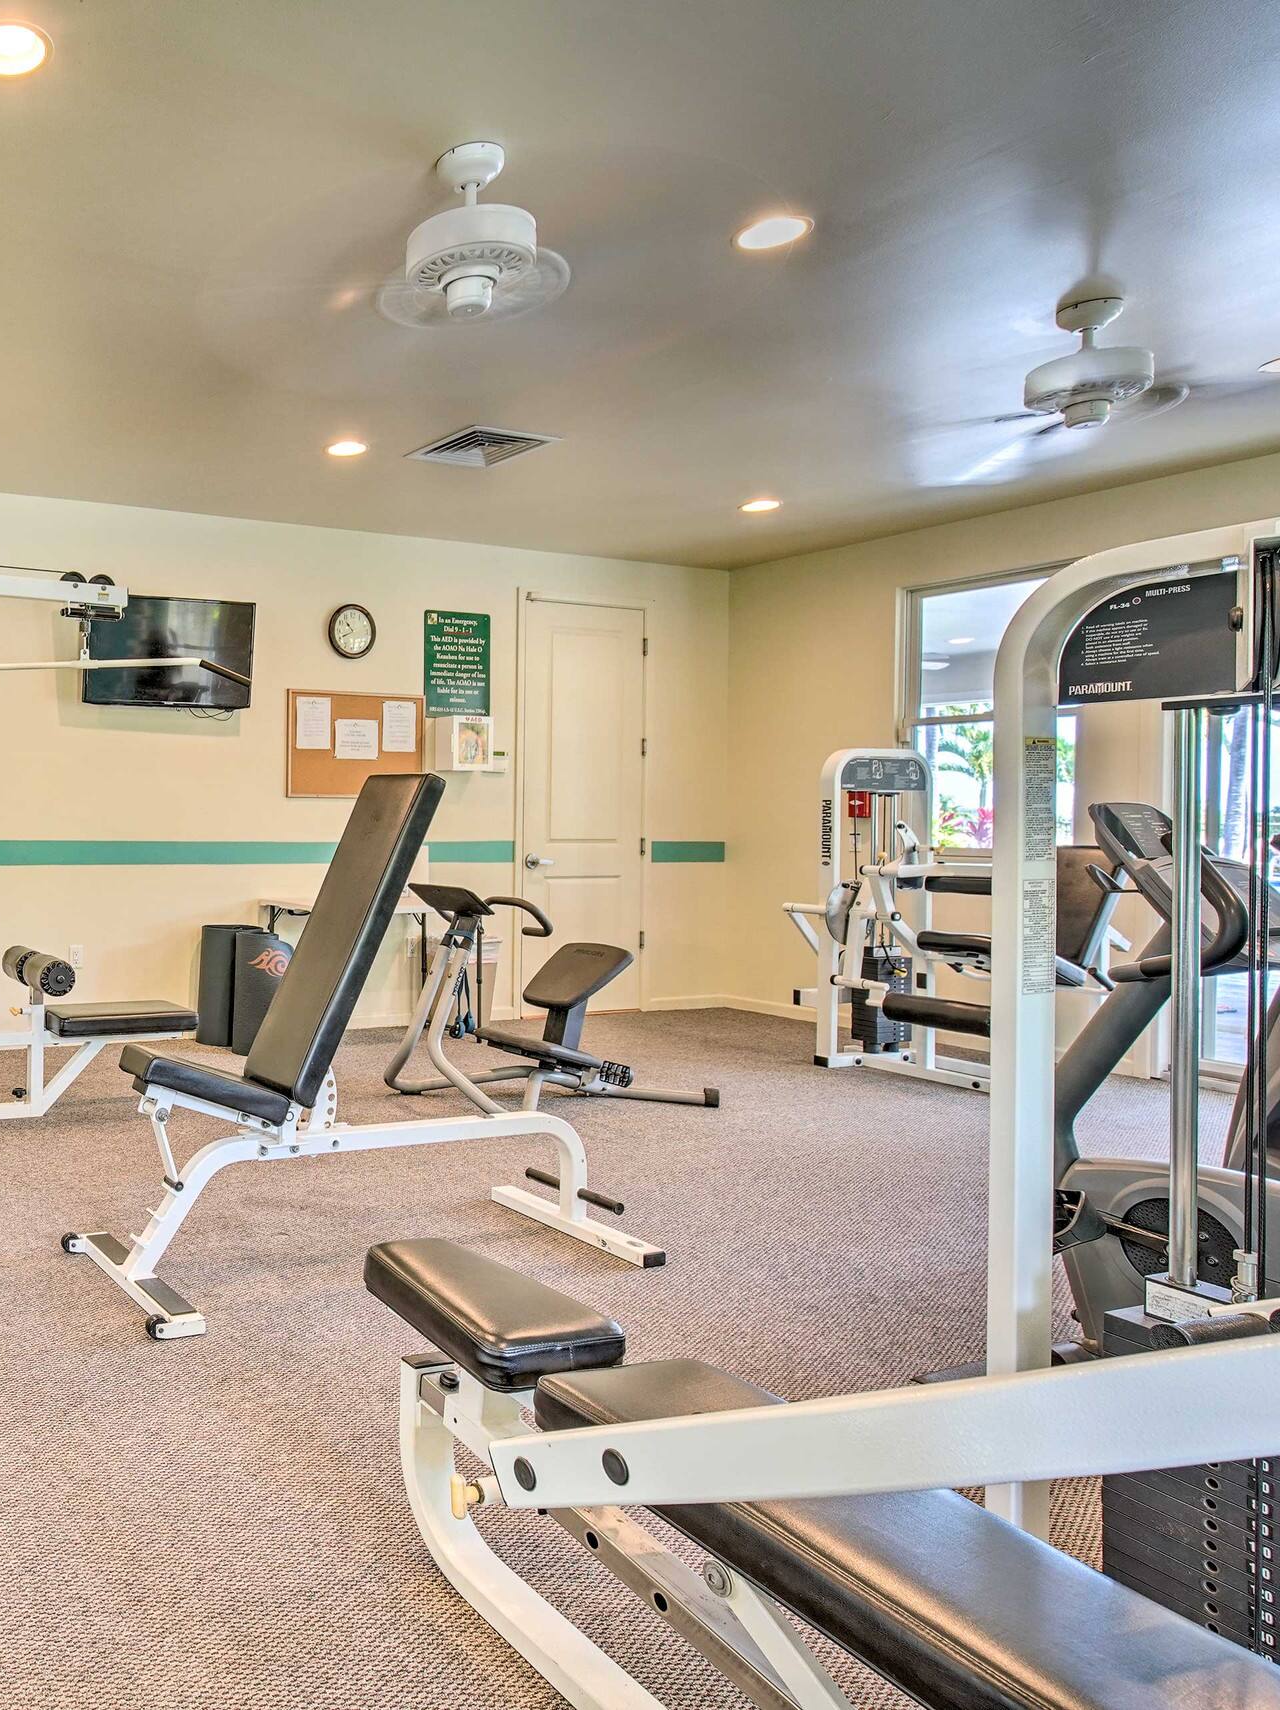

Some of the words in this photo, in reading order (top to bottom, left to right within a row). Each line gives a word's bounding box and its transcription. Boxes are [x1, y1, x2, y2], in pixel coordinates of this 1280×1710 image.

[1146, 585, 1191, 597] MULTI-PRESS
[480, 638, 486, 646] by
[455, 671, 471, 679] danger
[1069, 681, 1132, 695] PARAMOUNT
[822, 800, 832, 860] PARAMOUNT
